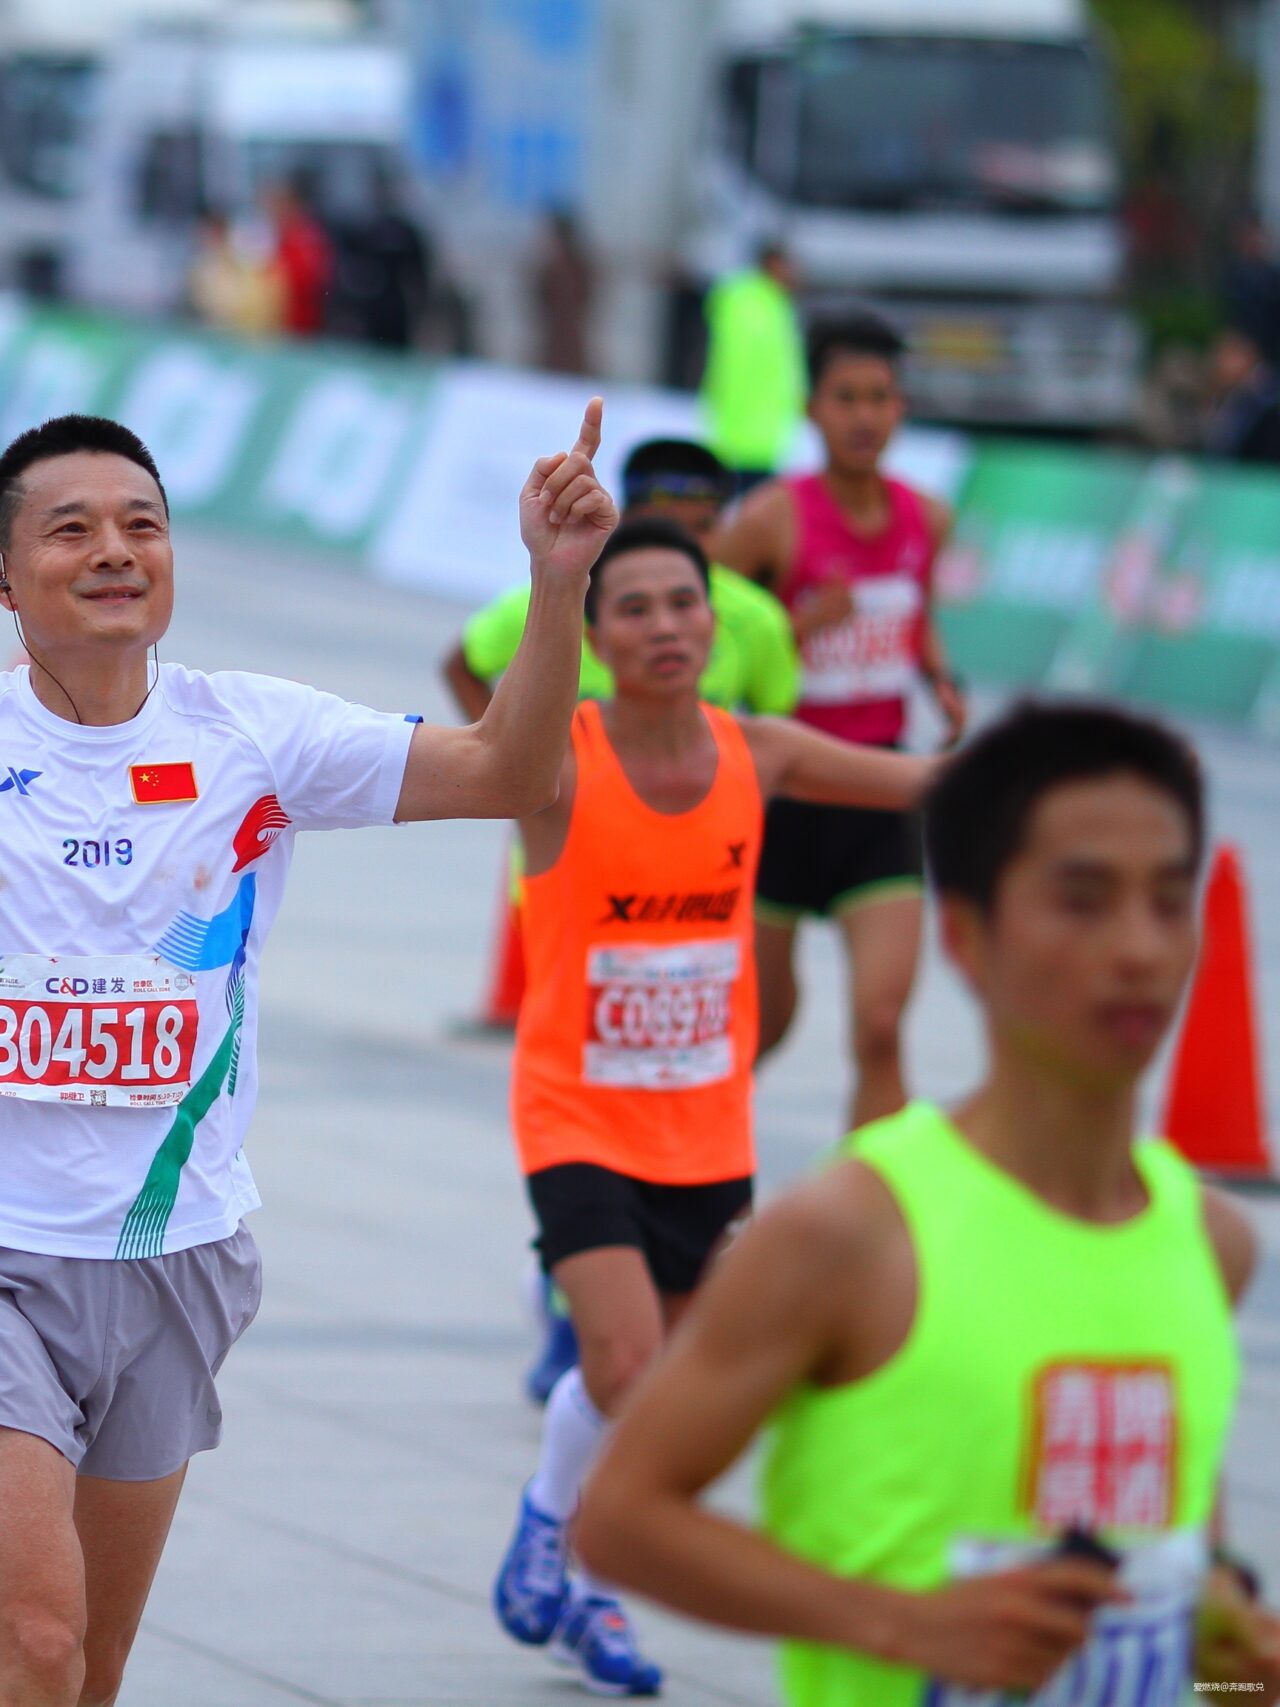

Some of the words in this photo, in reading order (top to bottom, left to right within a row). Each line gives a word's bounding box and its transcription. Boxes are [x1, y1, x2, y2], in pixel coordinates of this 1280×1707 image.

[62, 838, 133, 868] 2019
[45, 977, 89, 997] C&D
[92, 977, 126, 994] 建发
